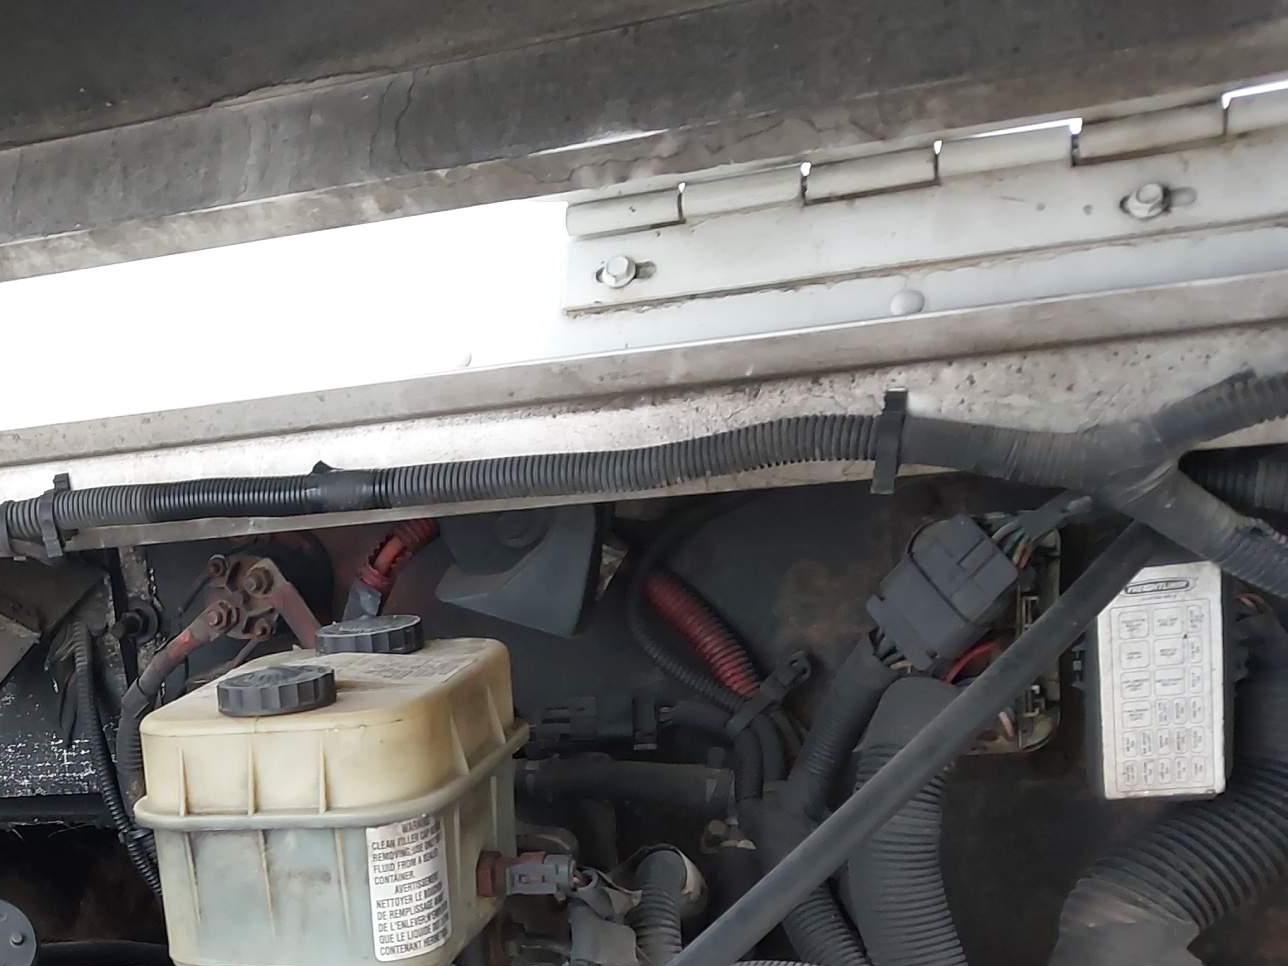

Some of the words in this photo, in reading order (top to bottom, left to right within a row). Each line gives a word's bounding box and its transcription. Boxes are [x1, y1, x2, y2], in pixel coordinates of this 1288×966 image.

[371, 839, 395, 850] CLEAN
[373, 862, 395, 873] FLUID
[397, 856, 416, 871] FROM
[376, 894, 413, 909] NETTOYER
[415, 890, 423, 902] LE
[376, 910, 388, 921] DE
[378, 922, 389, 933] DE
[379, 933, 394, 944] QUE
[397, 931, 406, 942] LE
[379, 940, 422, 956] CONTENANT
